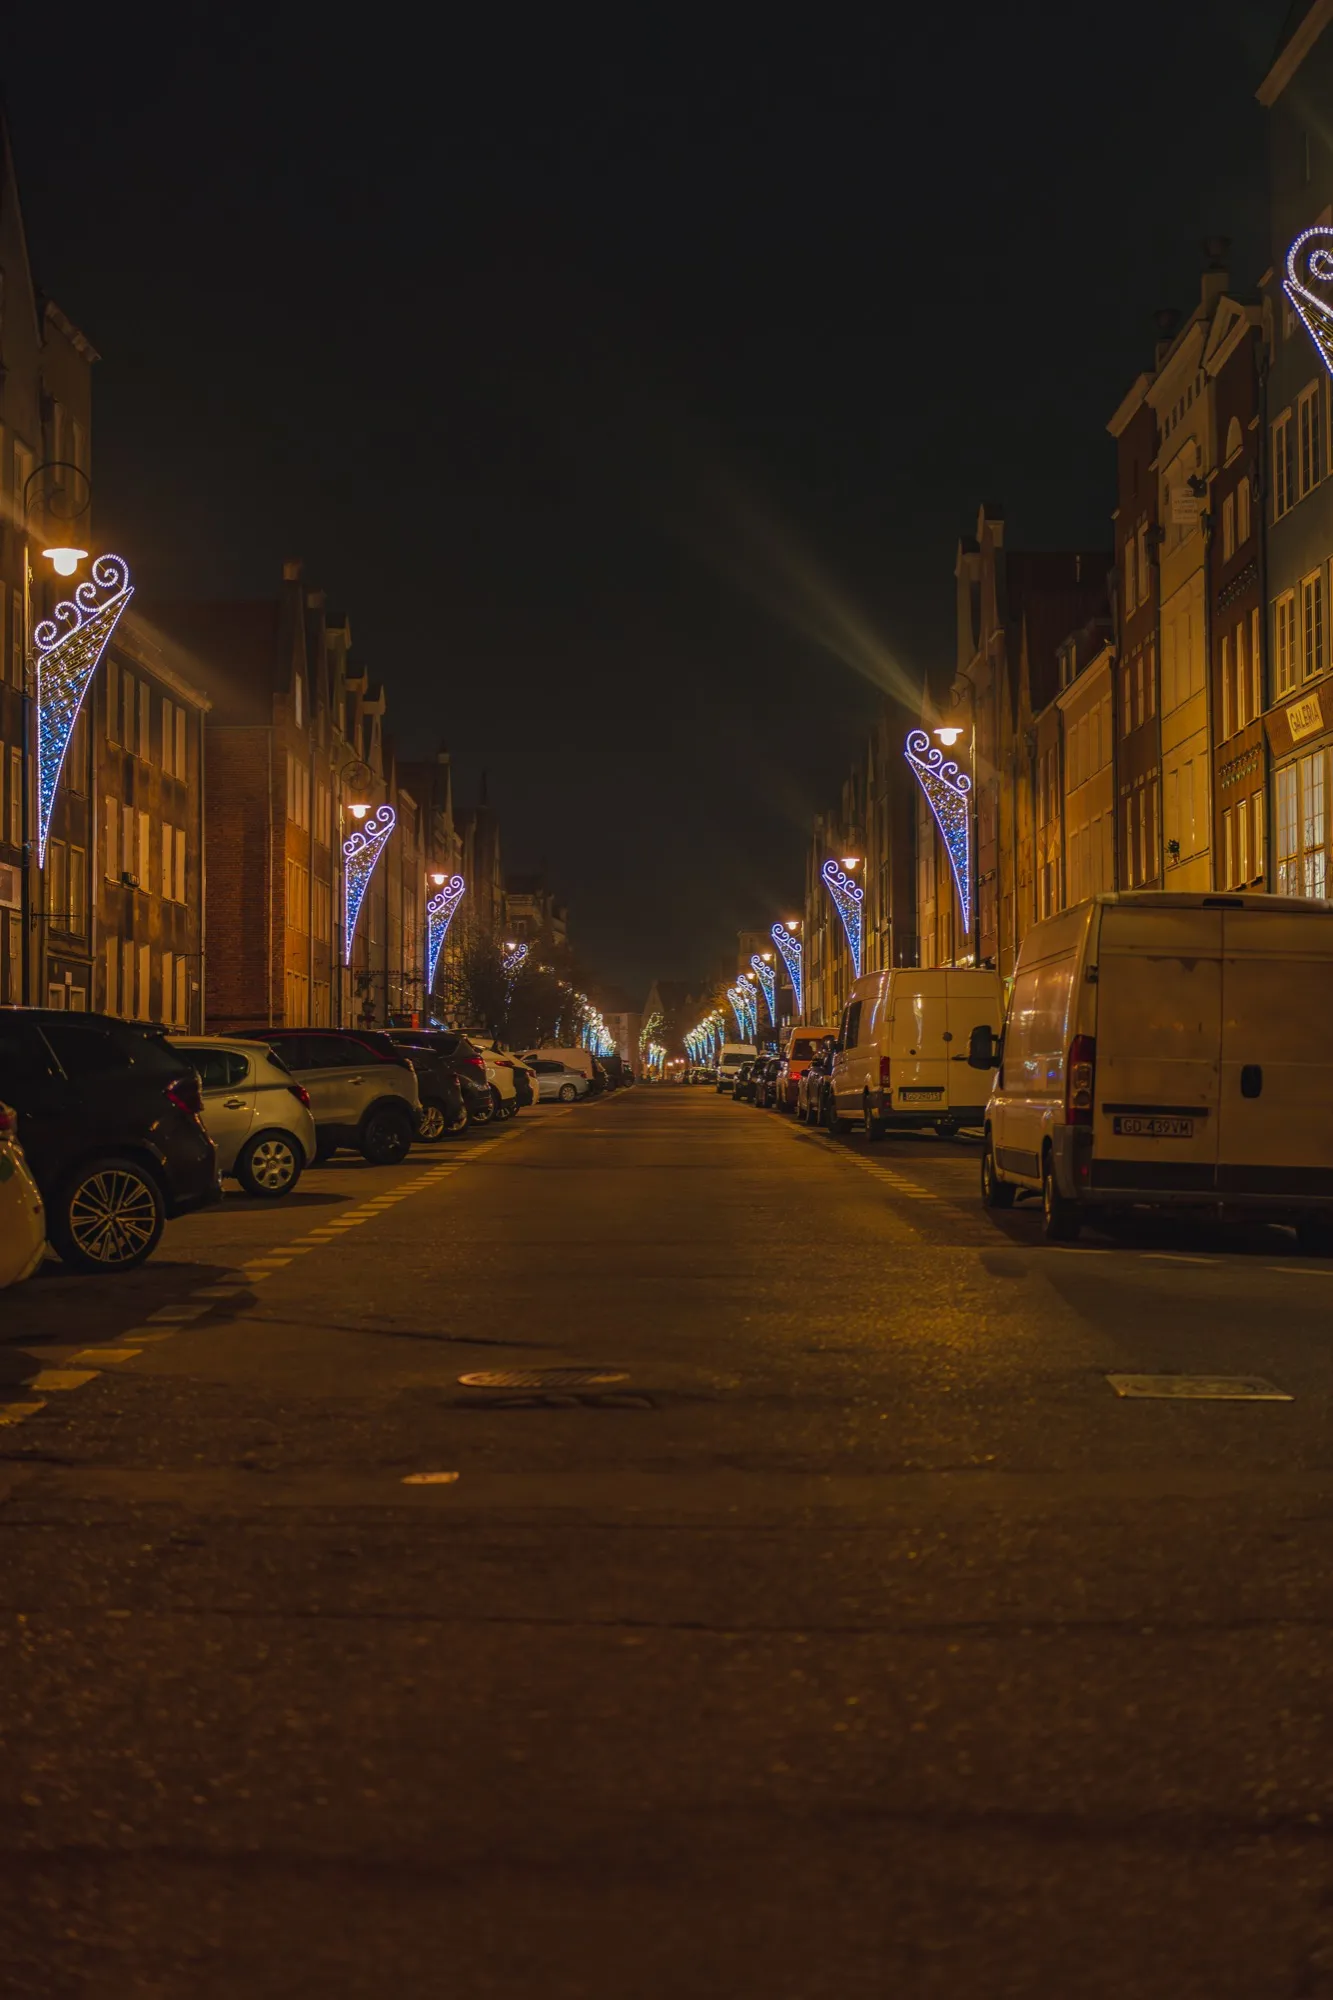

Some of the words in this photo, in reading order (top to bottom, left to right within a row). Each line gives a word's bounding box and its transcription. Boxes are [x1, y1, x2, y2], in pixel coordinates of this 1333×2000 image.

[1289, 702, 1320, 732] GALERIA
[1123, 1119, 1142, 1133] GD
[1147, 1119, 1189, 1134] 439VM
